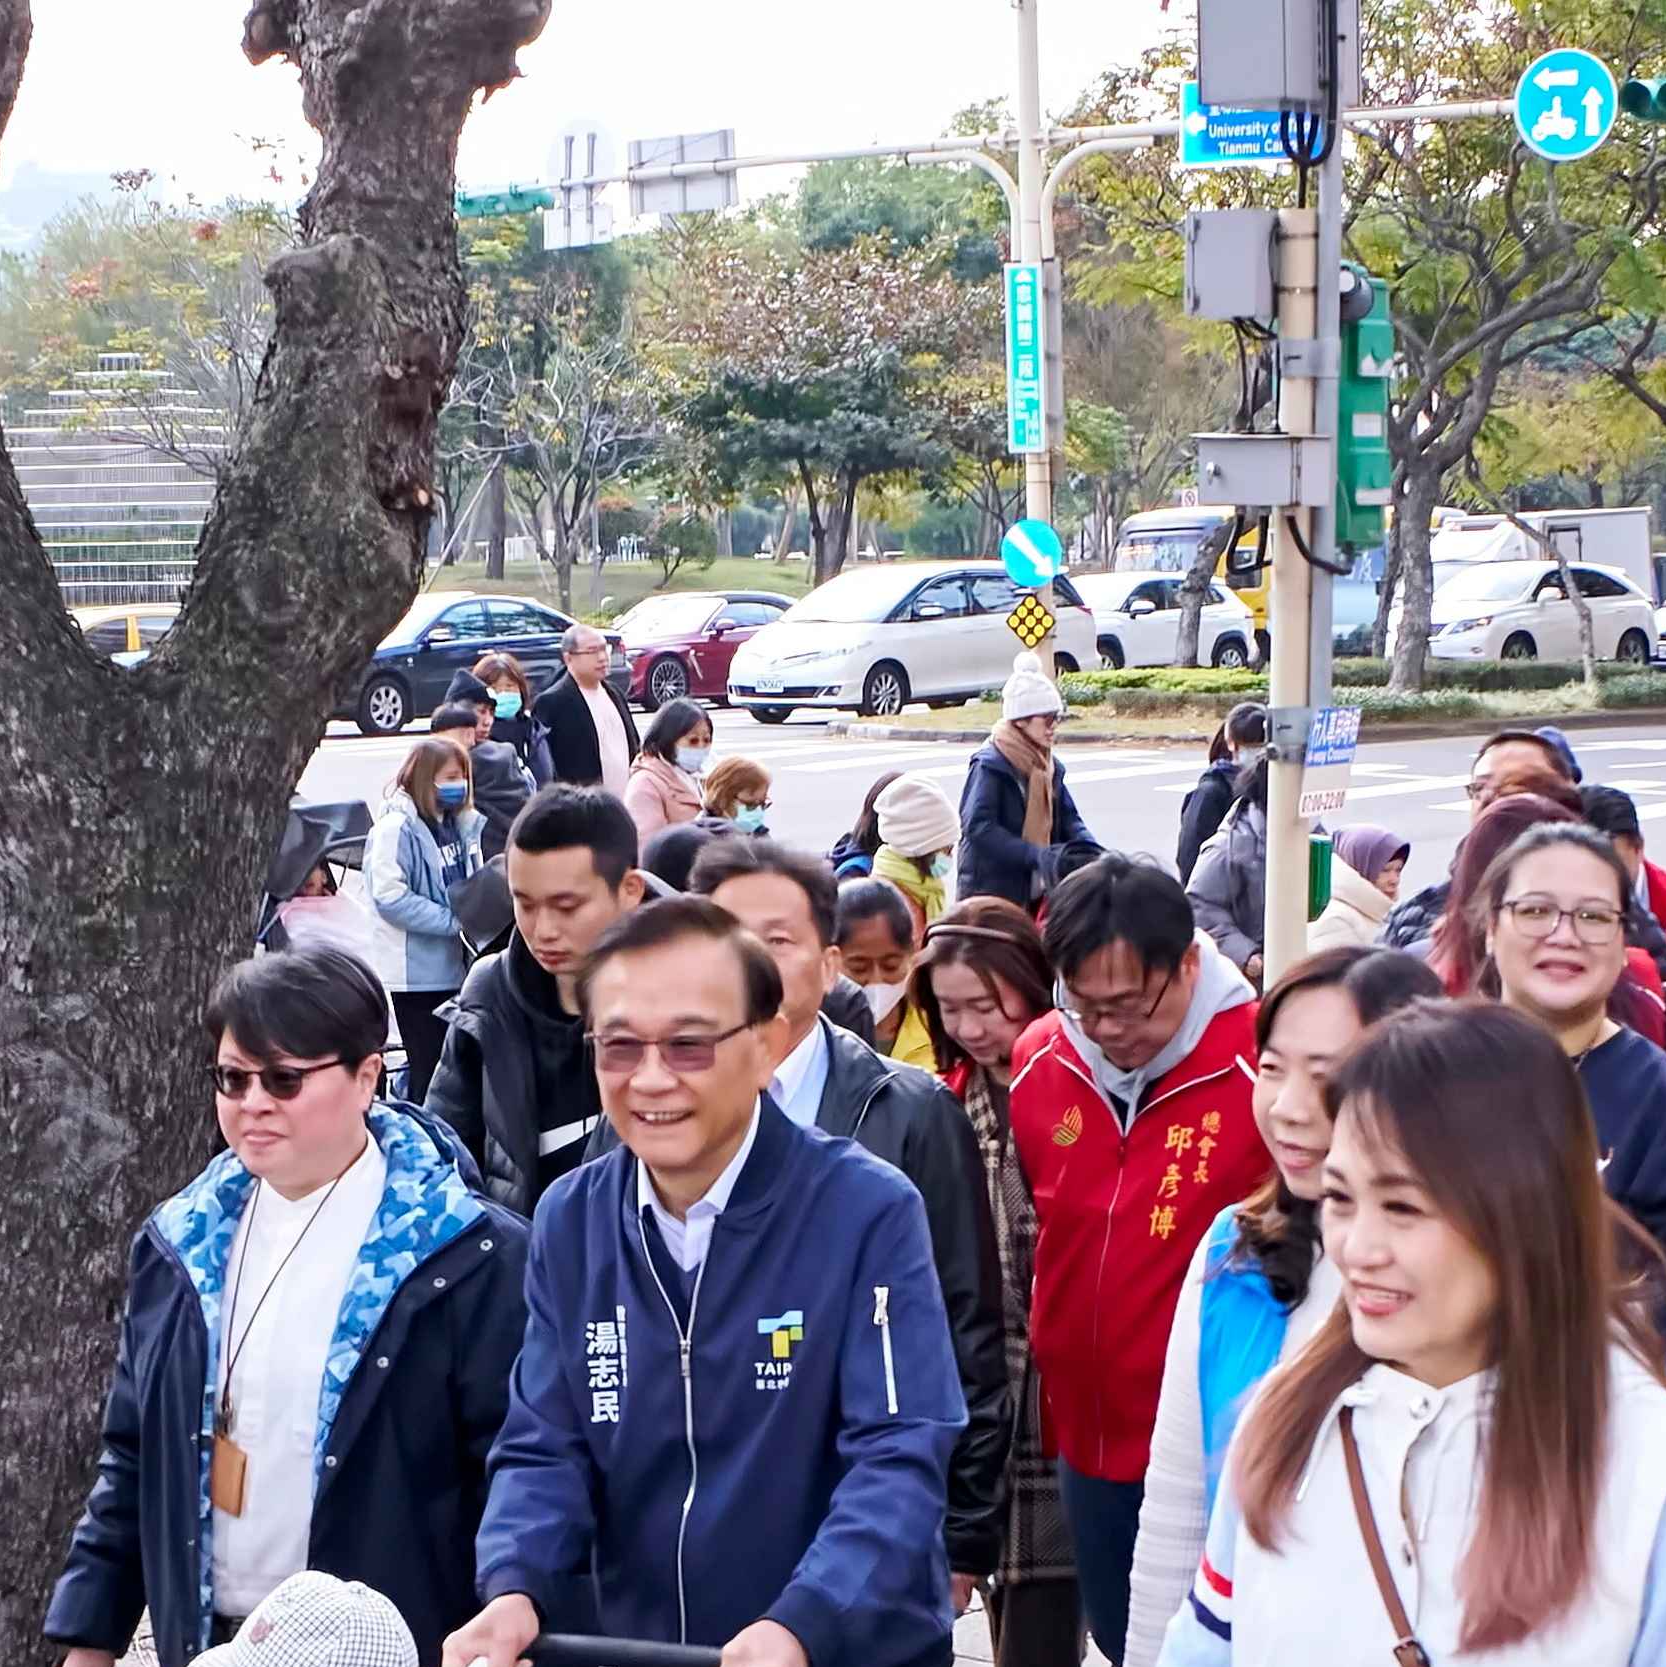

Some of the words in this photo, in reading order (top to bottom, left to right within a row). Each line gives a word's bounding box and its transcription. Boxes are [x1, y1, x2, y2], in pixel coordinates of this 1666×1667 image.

[1208, 120, 1270, 139] University
[1218, 141, 1261, 155] Tianmu
[1149, 1123, 1195, 1241] 邱彥博
[585, 1321, 620, 1424] 湯志民
[754, 1361, 793, 1377] TAIP
